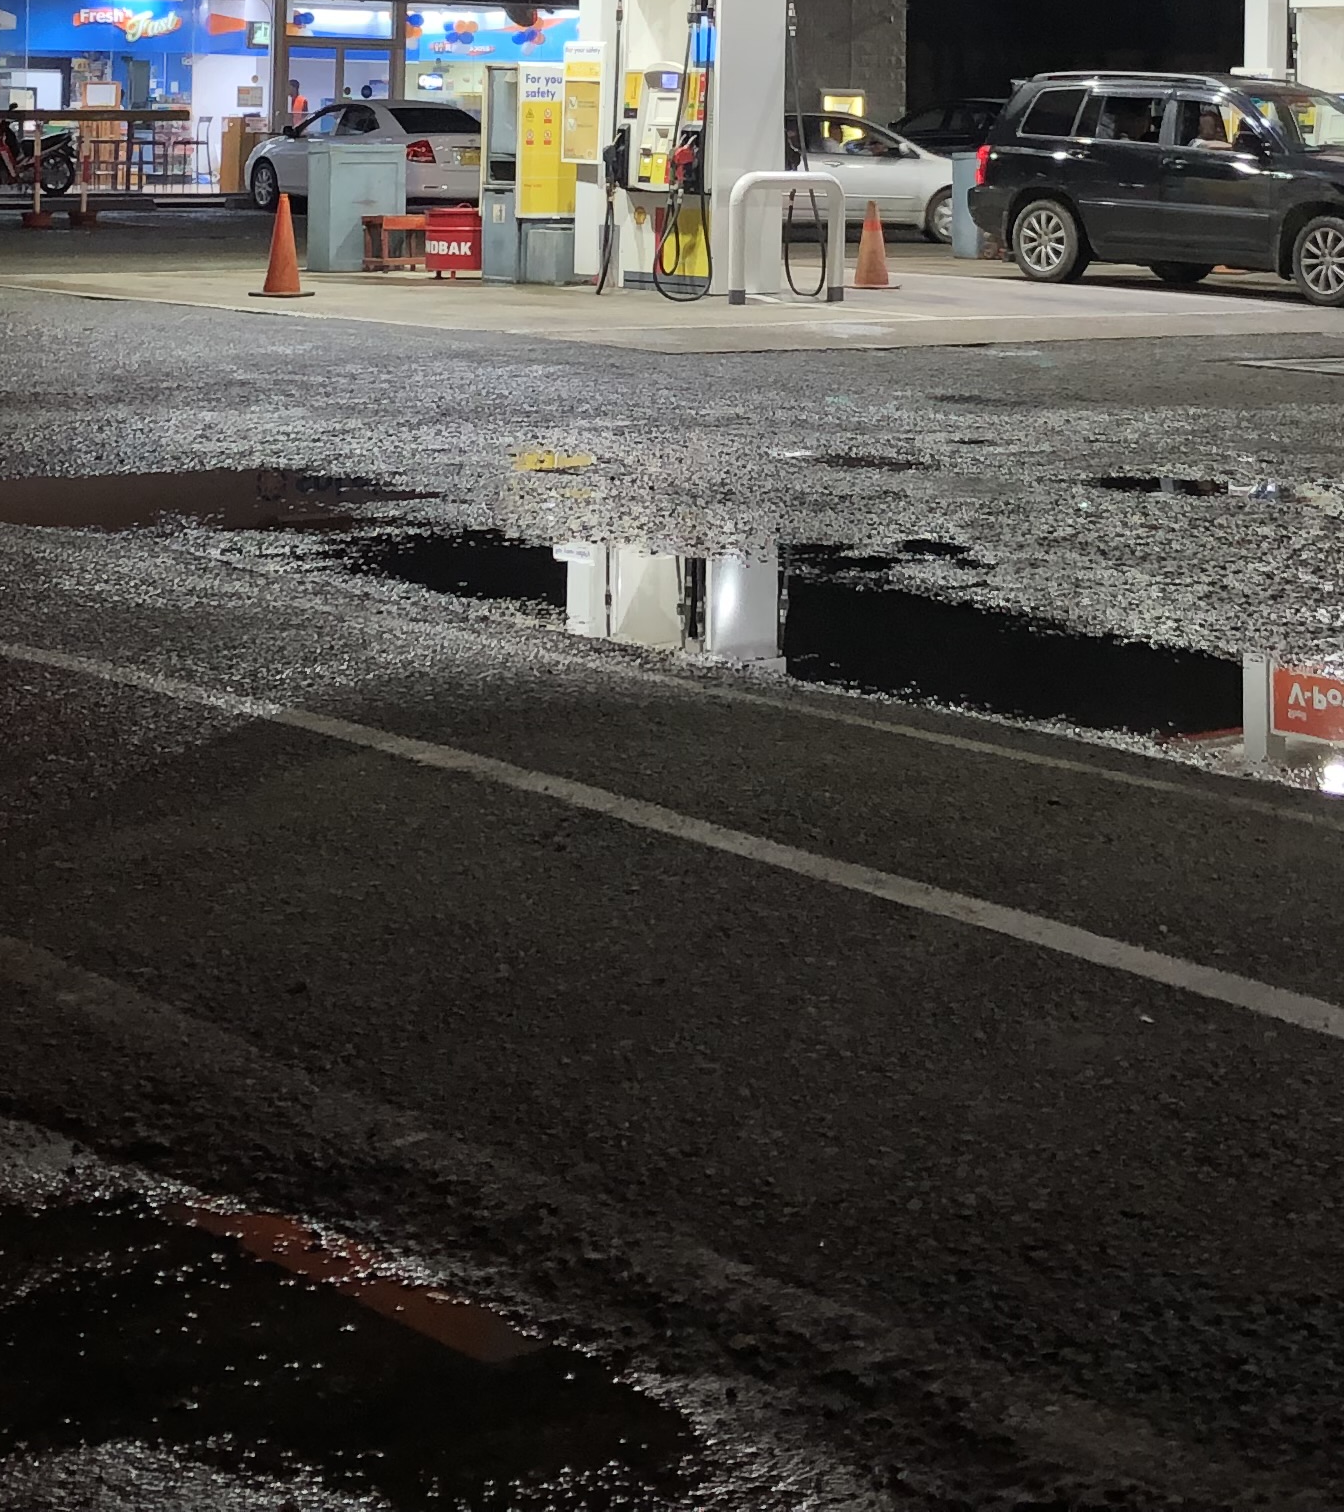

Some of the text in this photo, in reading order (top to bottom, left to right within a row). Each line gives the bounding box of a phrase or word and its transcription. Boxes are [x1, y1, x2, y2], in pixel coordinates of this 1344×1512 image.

[525, 73, 563, 87] For you
[525, 89, 556, 101] safety
